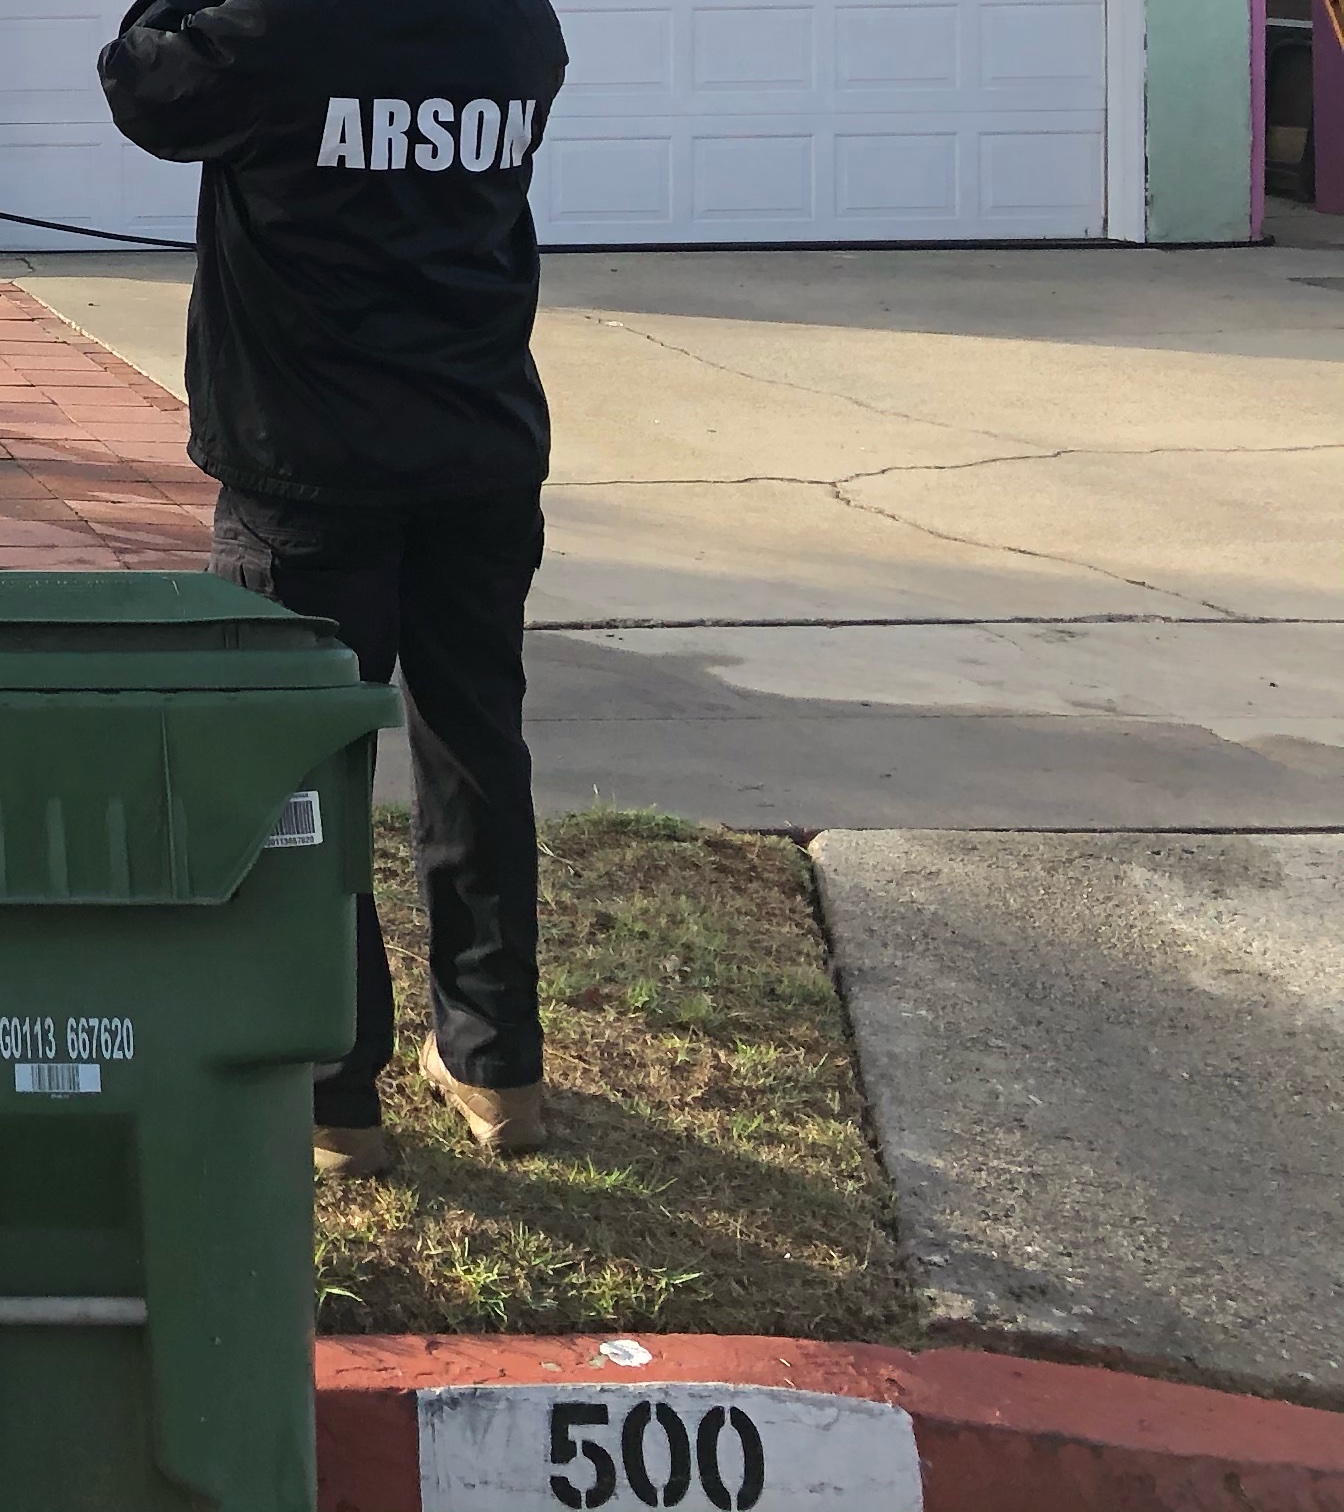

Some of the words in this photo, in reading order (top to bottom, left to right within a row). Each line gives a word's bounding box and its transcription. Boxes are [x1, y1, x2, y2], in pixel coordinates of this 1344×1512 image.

[316, 96, 537, 172] ARSON
[66, 1016, 134, 1059] 667620
[550, 1400, 765, 1511] 500
